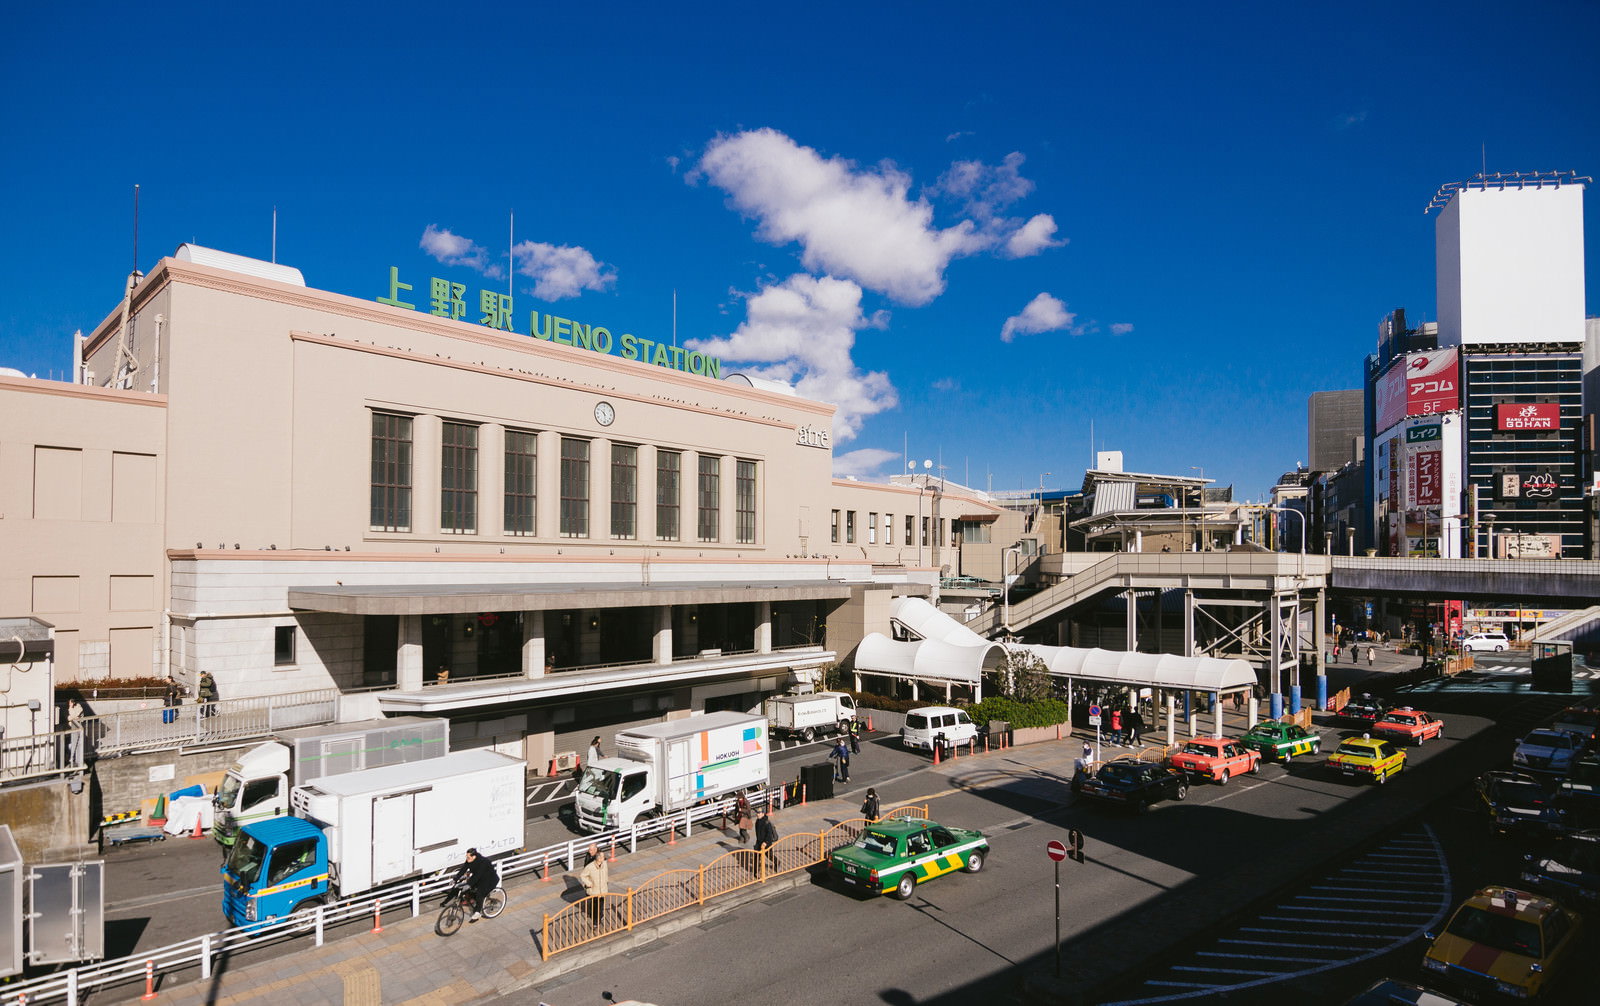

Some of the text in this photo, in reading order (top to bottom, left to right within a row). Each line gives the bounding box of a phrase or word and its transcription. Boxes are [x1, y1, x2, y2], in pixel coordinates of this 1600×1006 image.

[376, 266, 514, 332] 上野駅
[530, 310, 721, 380] UENO STATION
[1410, 379, 1454, 396] アコム
[1423, 401, 1441, 412] 5F
[1410, 428, 1438, 440] レイク
[1420, 454, 1433, 497] アイフル
[715, 749, 740, 761] HOKUOH
